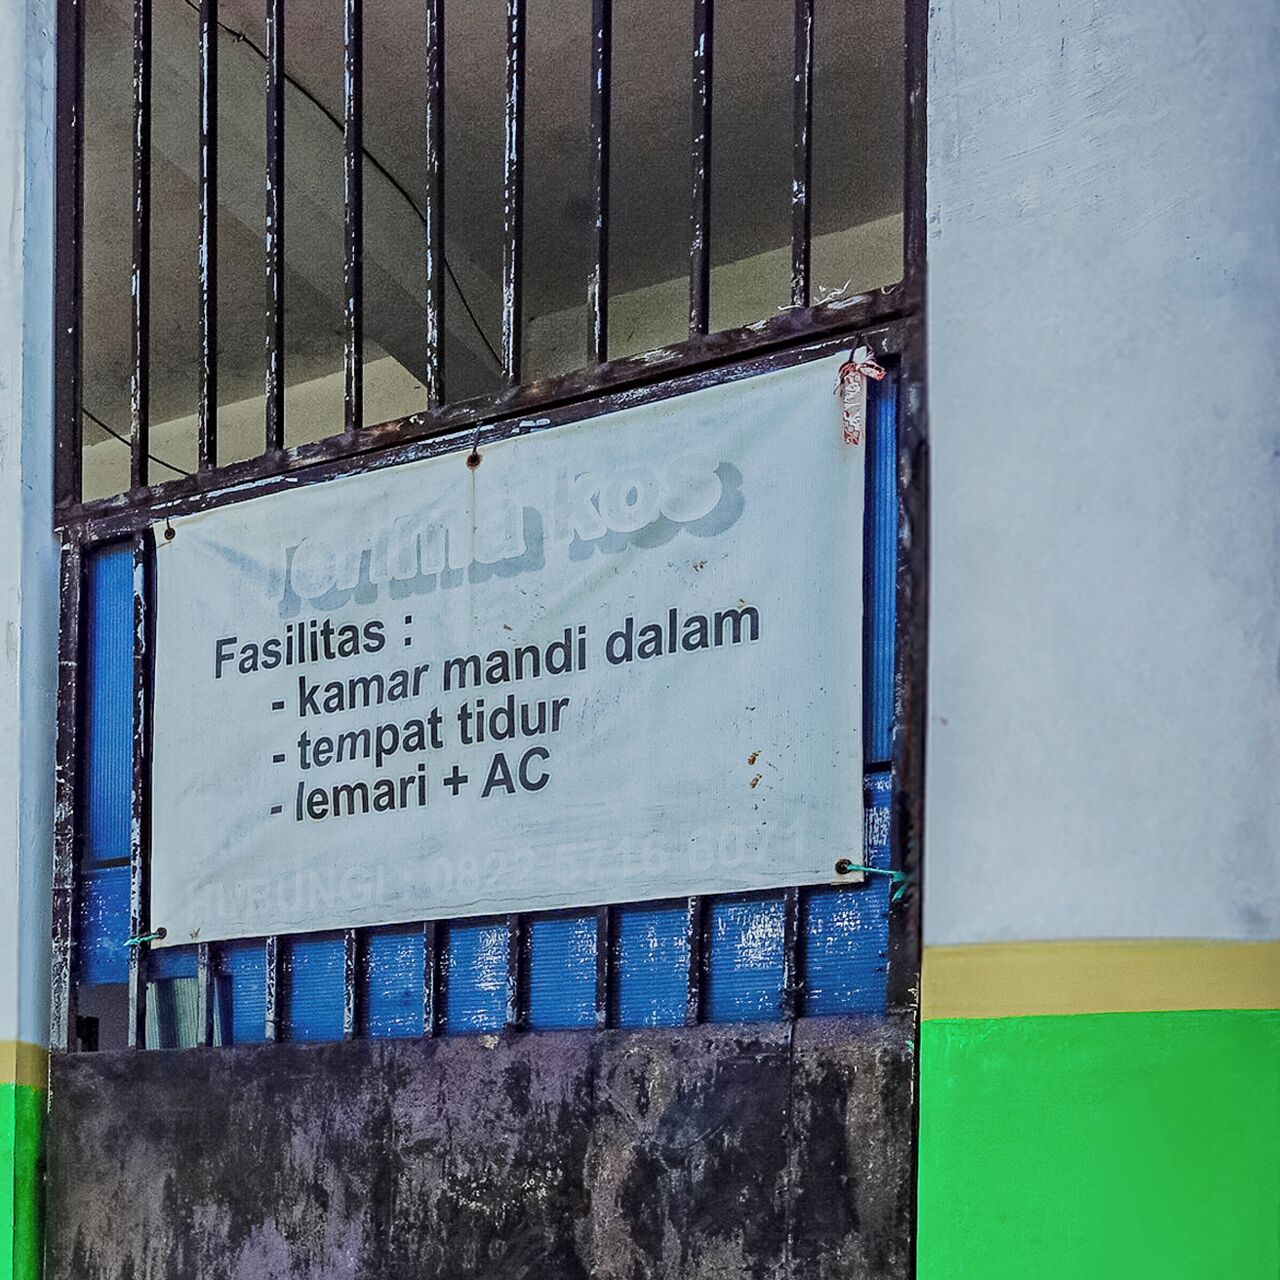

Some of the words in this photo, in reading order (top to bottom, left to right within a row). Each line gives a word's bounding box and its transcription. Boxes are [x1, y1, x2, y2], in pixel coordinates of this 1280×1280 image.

[214, 618, 387, 680] Fasilitas
[298, 663, 430, 718] kamar
[443, 625, 587, 692] mandi
[605, 605, 760, 666] dalam
[297, 706, 444, 771] tempat
[457, 694, 571, 745] tidur
[296, 763, 427, 822] lemari
[481, 746, 551, 798] AC
